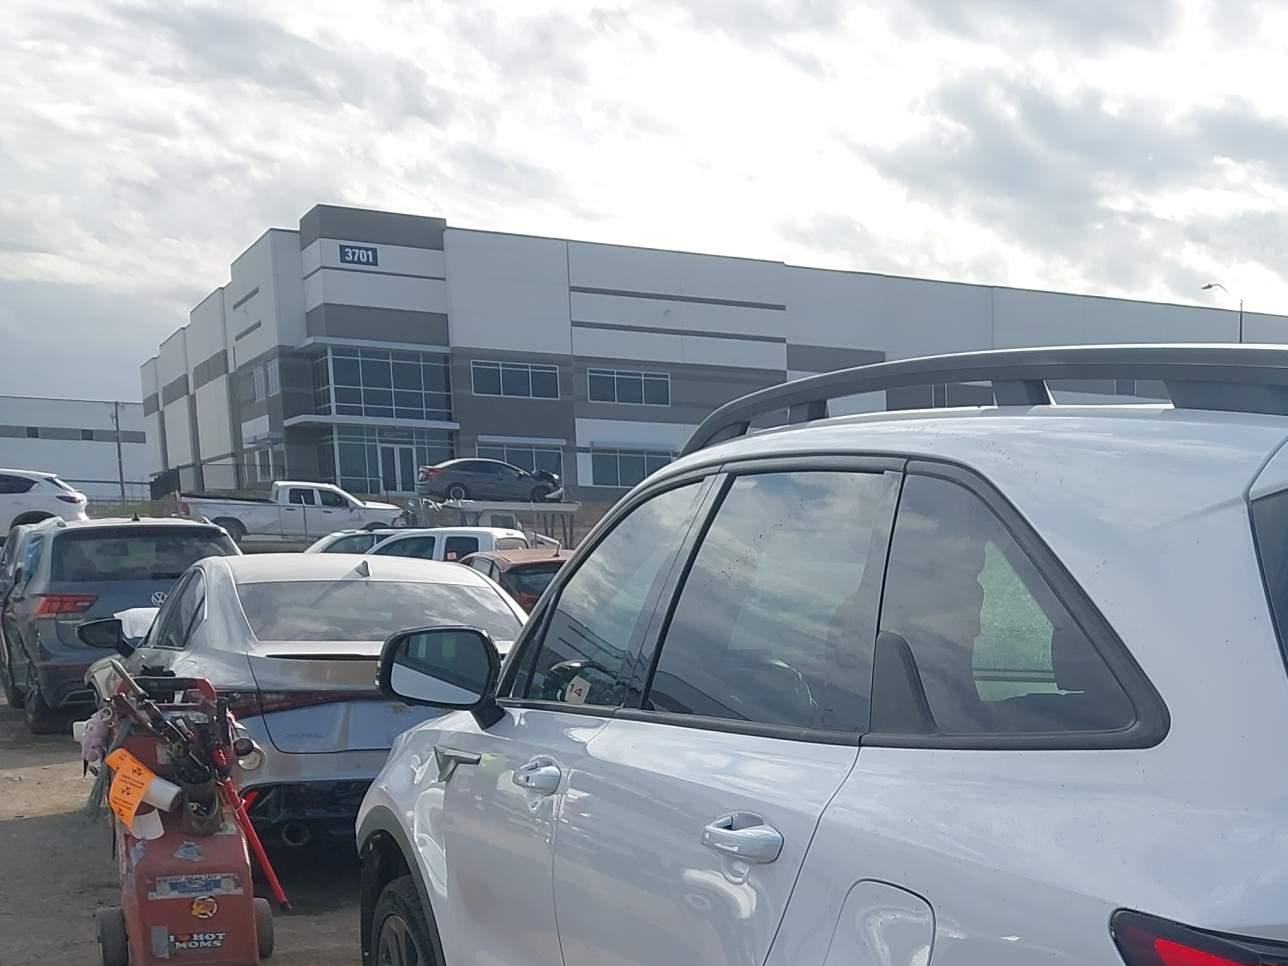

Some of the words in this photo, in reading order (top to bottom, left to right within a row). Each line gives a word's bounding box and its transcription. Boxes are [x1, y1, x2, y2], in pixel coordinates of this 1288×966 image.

[344, 248, 374, 263] 3701
[192, 932, 227, 941] HOT
[174, 940, 223, 949] MOMS
